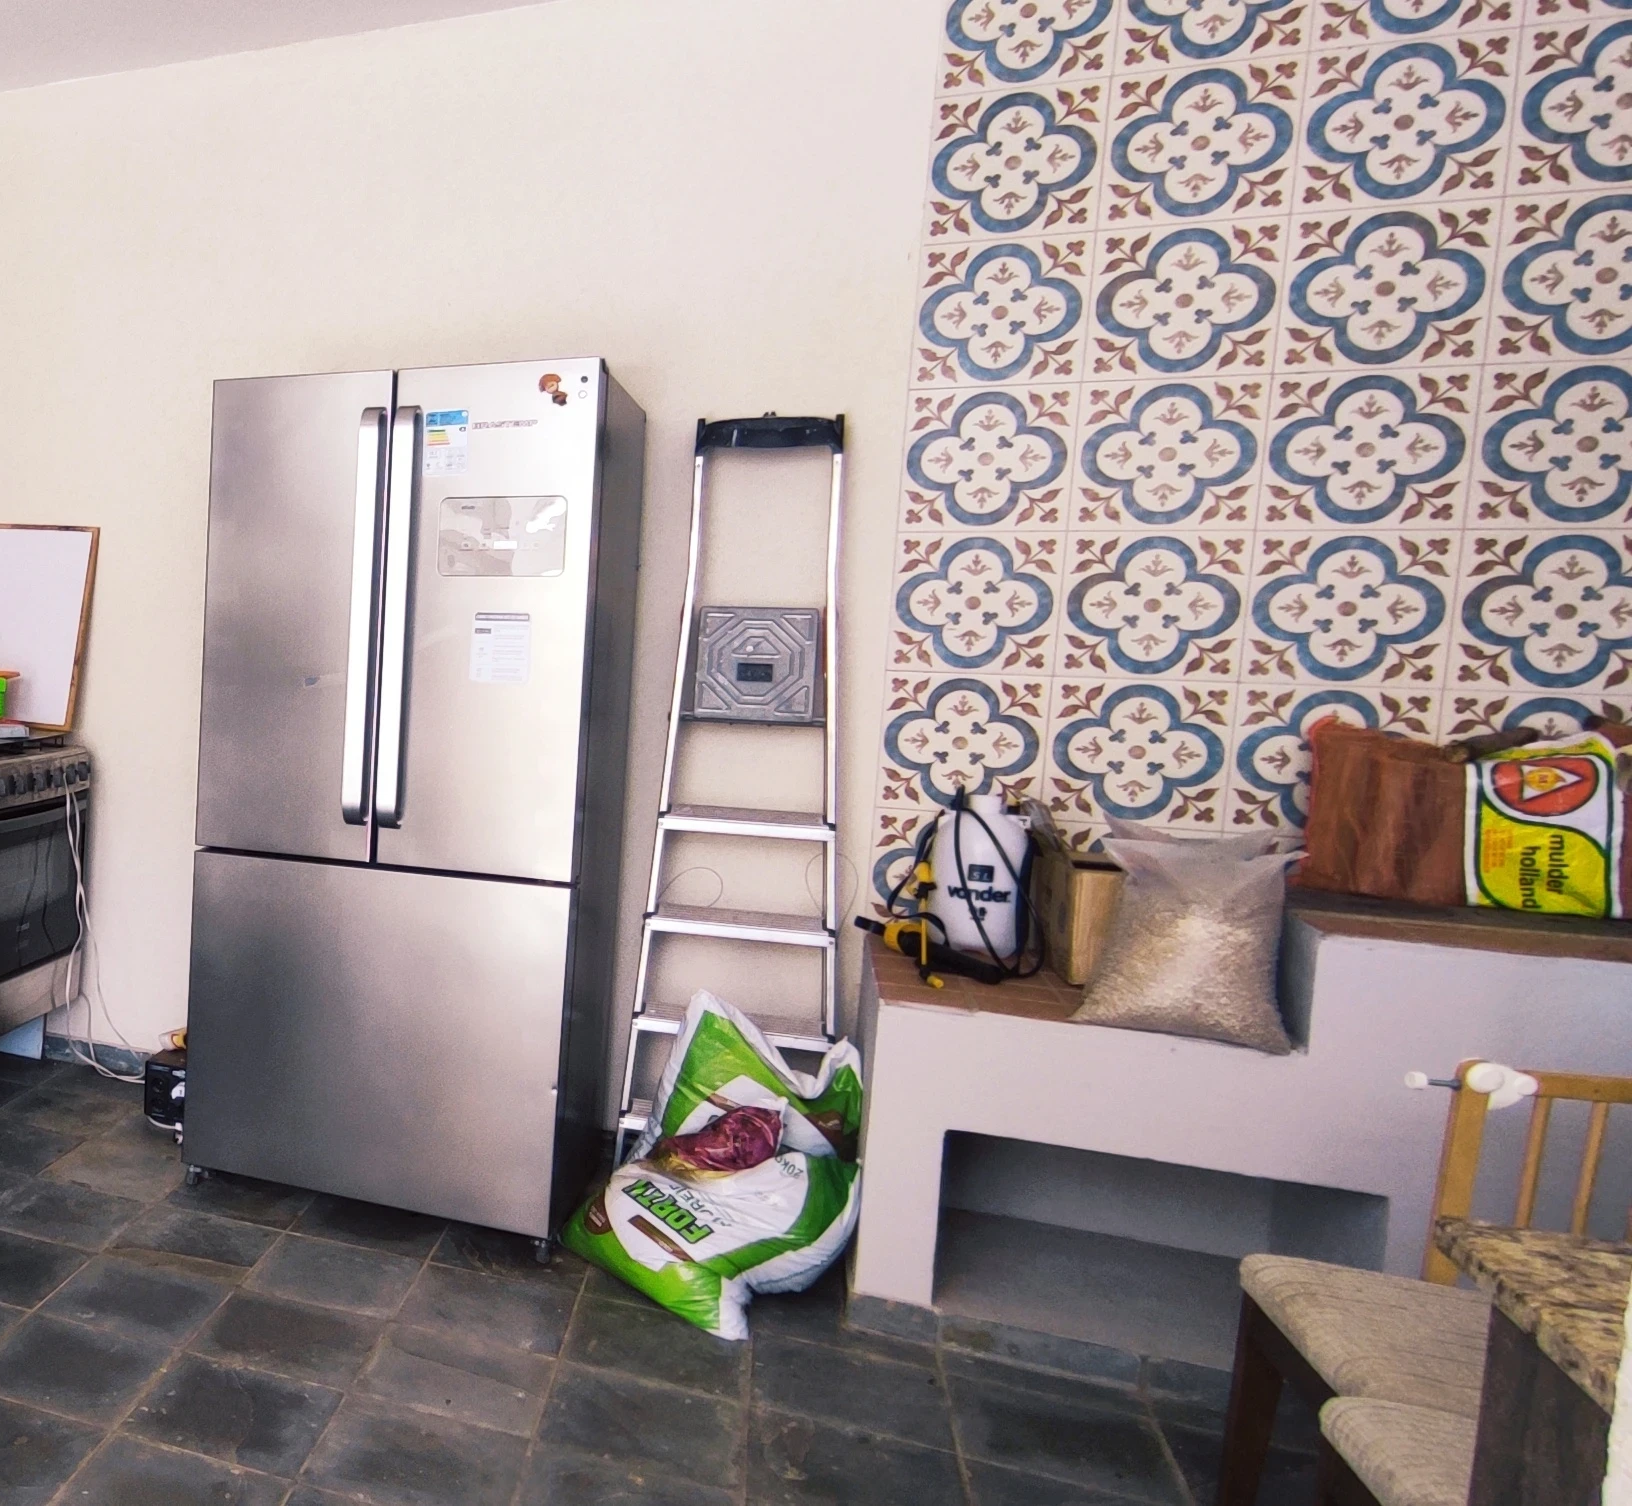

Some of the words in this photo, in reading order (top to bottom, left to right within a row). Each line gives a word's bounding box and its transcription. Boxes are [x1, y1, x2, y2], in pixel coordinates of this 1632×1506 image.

[948, 885, 1011, 903] vonder
[1519, 845, 1542, 909] holland
[1547, 834, 1569, 894] mulder
[621, 1179, 715, 1244] FORTH
